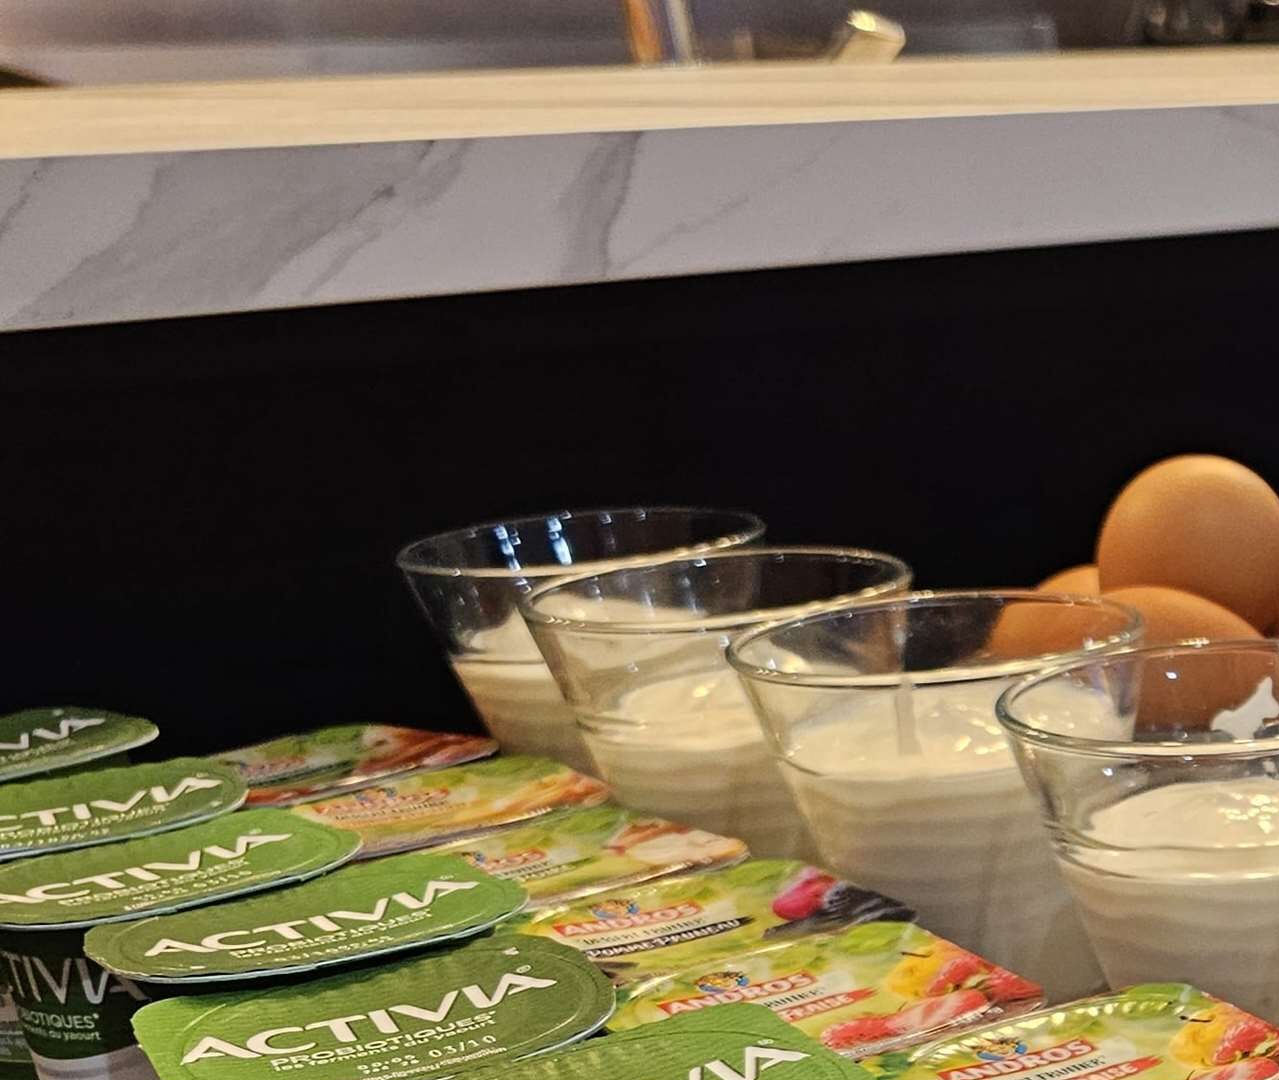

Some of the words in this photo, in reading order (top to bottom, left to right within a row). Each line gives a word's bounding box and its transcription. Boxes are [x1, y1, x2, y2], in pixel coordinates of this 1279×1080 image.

[144, 880, 480, 957] ACTIVIA
[562, 902, 698, 936] ANDROS
[180, 969, 558, 1066] ACTIVIA
[668, 973, 813, 1014] ANDROS
[270, 1012, 495, 1068] PROBIOTIQUES
